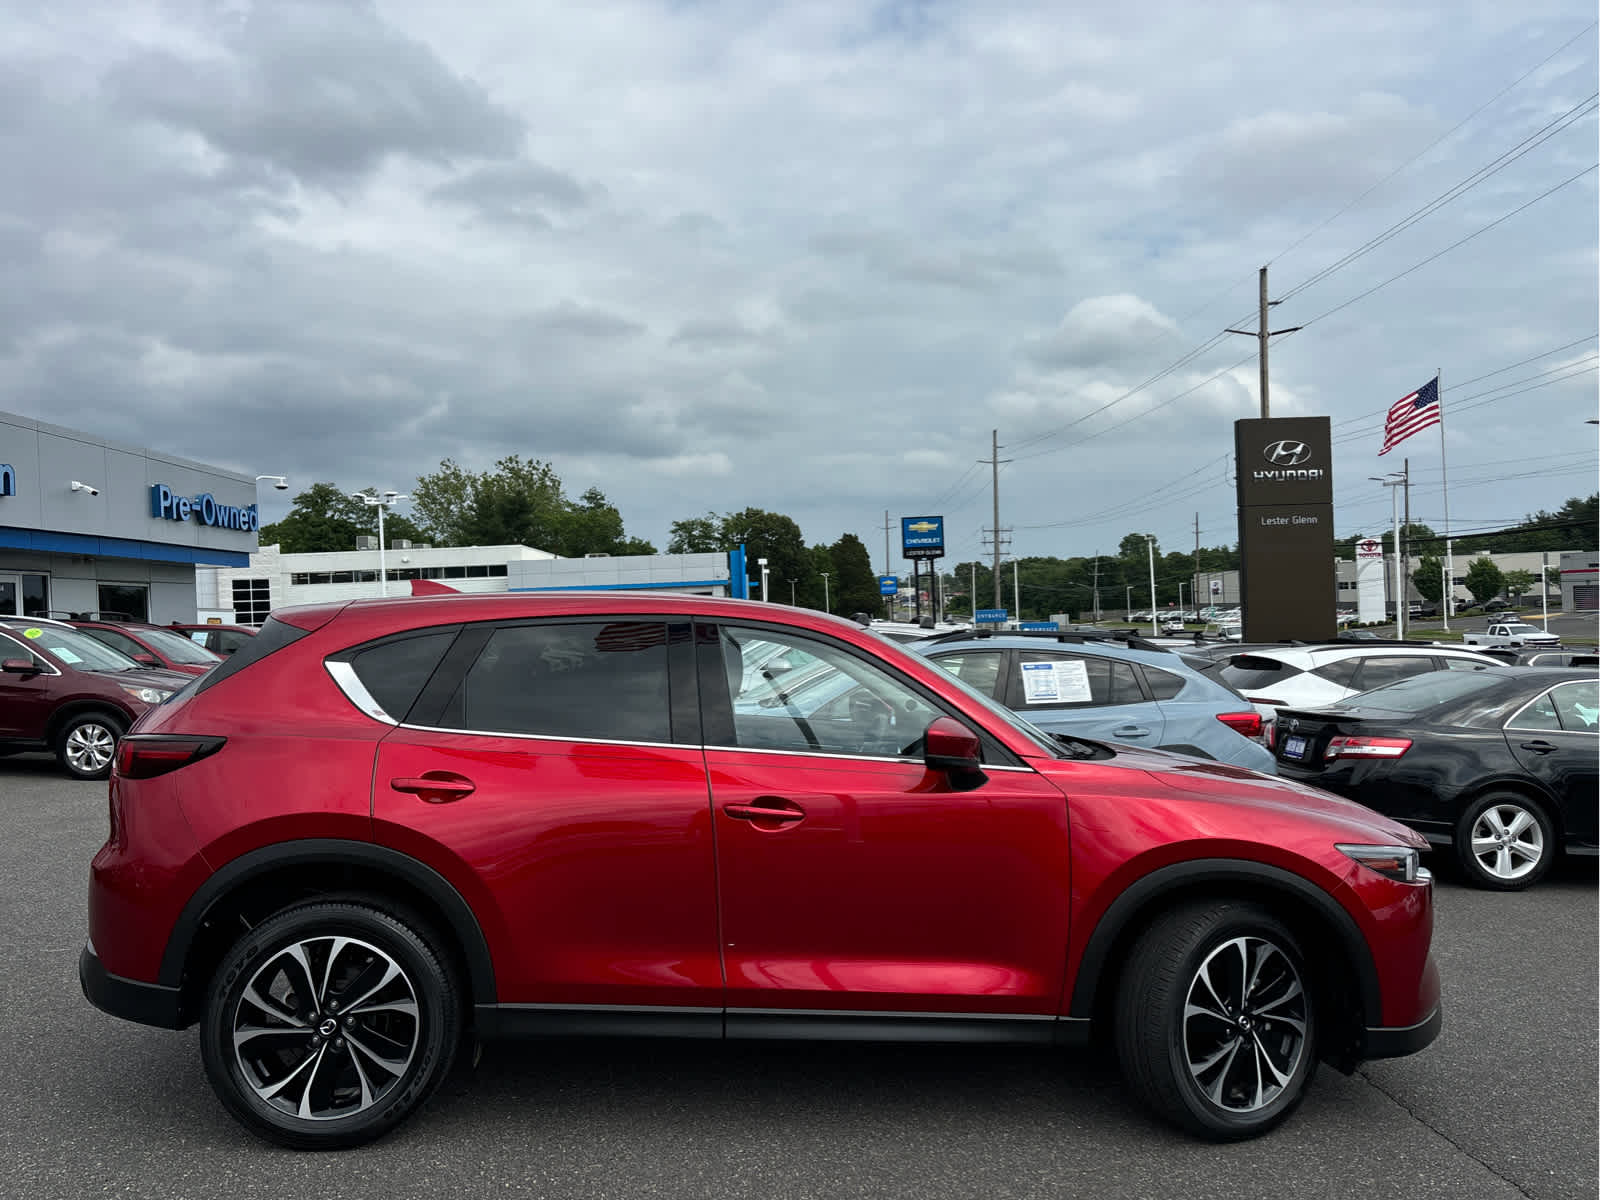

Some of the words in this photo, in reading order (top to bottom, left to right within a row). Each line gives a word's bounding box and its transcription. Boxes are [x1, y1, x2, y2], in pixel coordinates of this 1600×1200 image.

[1253, 469, 1323, 482] HYUNDAI
[152, 484, 258, 532] Pre-Owned
[1261, 516, 1289, 526] Lester
[1292, 515, 1318, 525] Glenn
